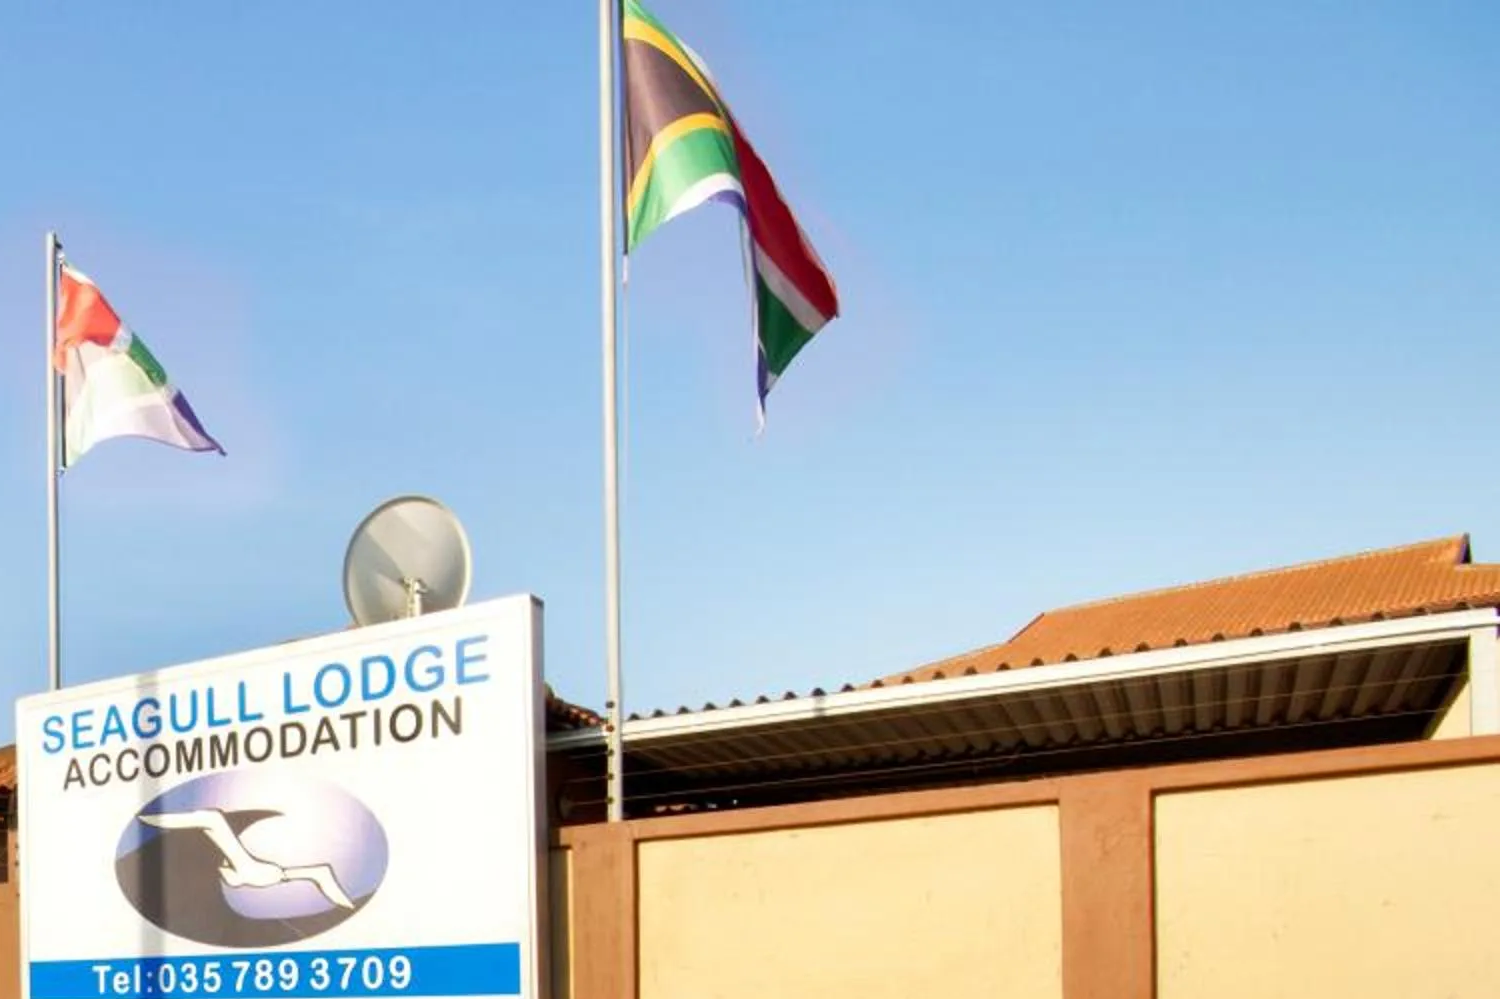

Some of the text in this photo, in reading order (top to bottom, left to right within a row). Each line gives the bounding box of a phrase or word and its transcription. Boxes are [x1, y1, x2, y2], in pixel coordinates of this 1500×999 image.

[42, 635, 490, 754] SEAGULL LODGE
[63, 696, 462, 790] ACCOMMODATION
[231, 958, 299, 992] 789
[309, 955, 412, 990] 3709
